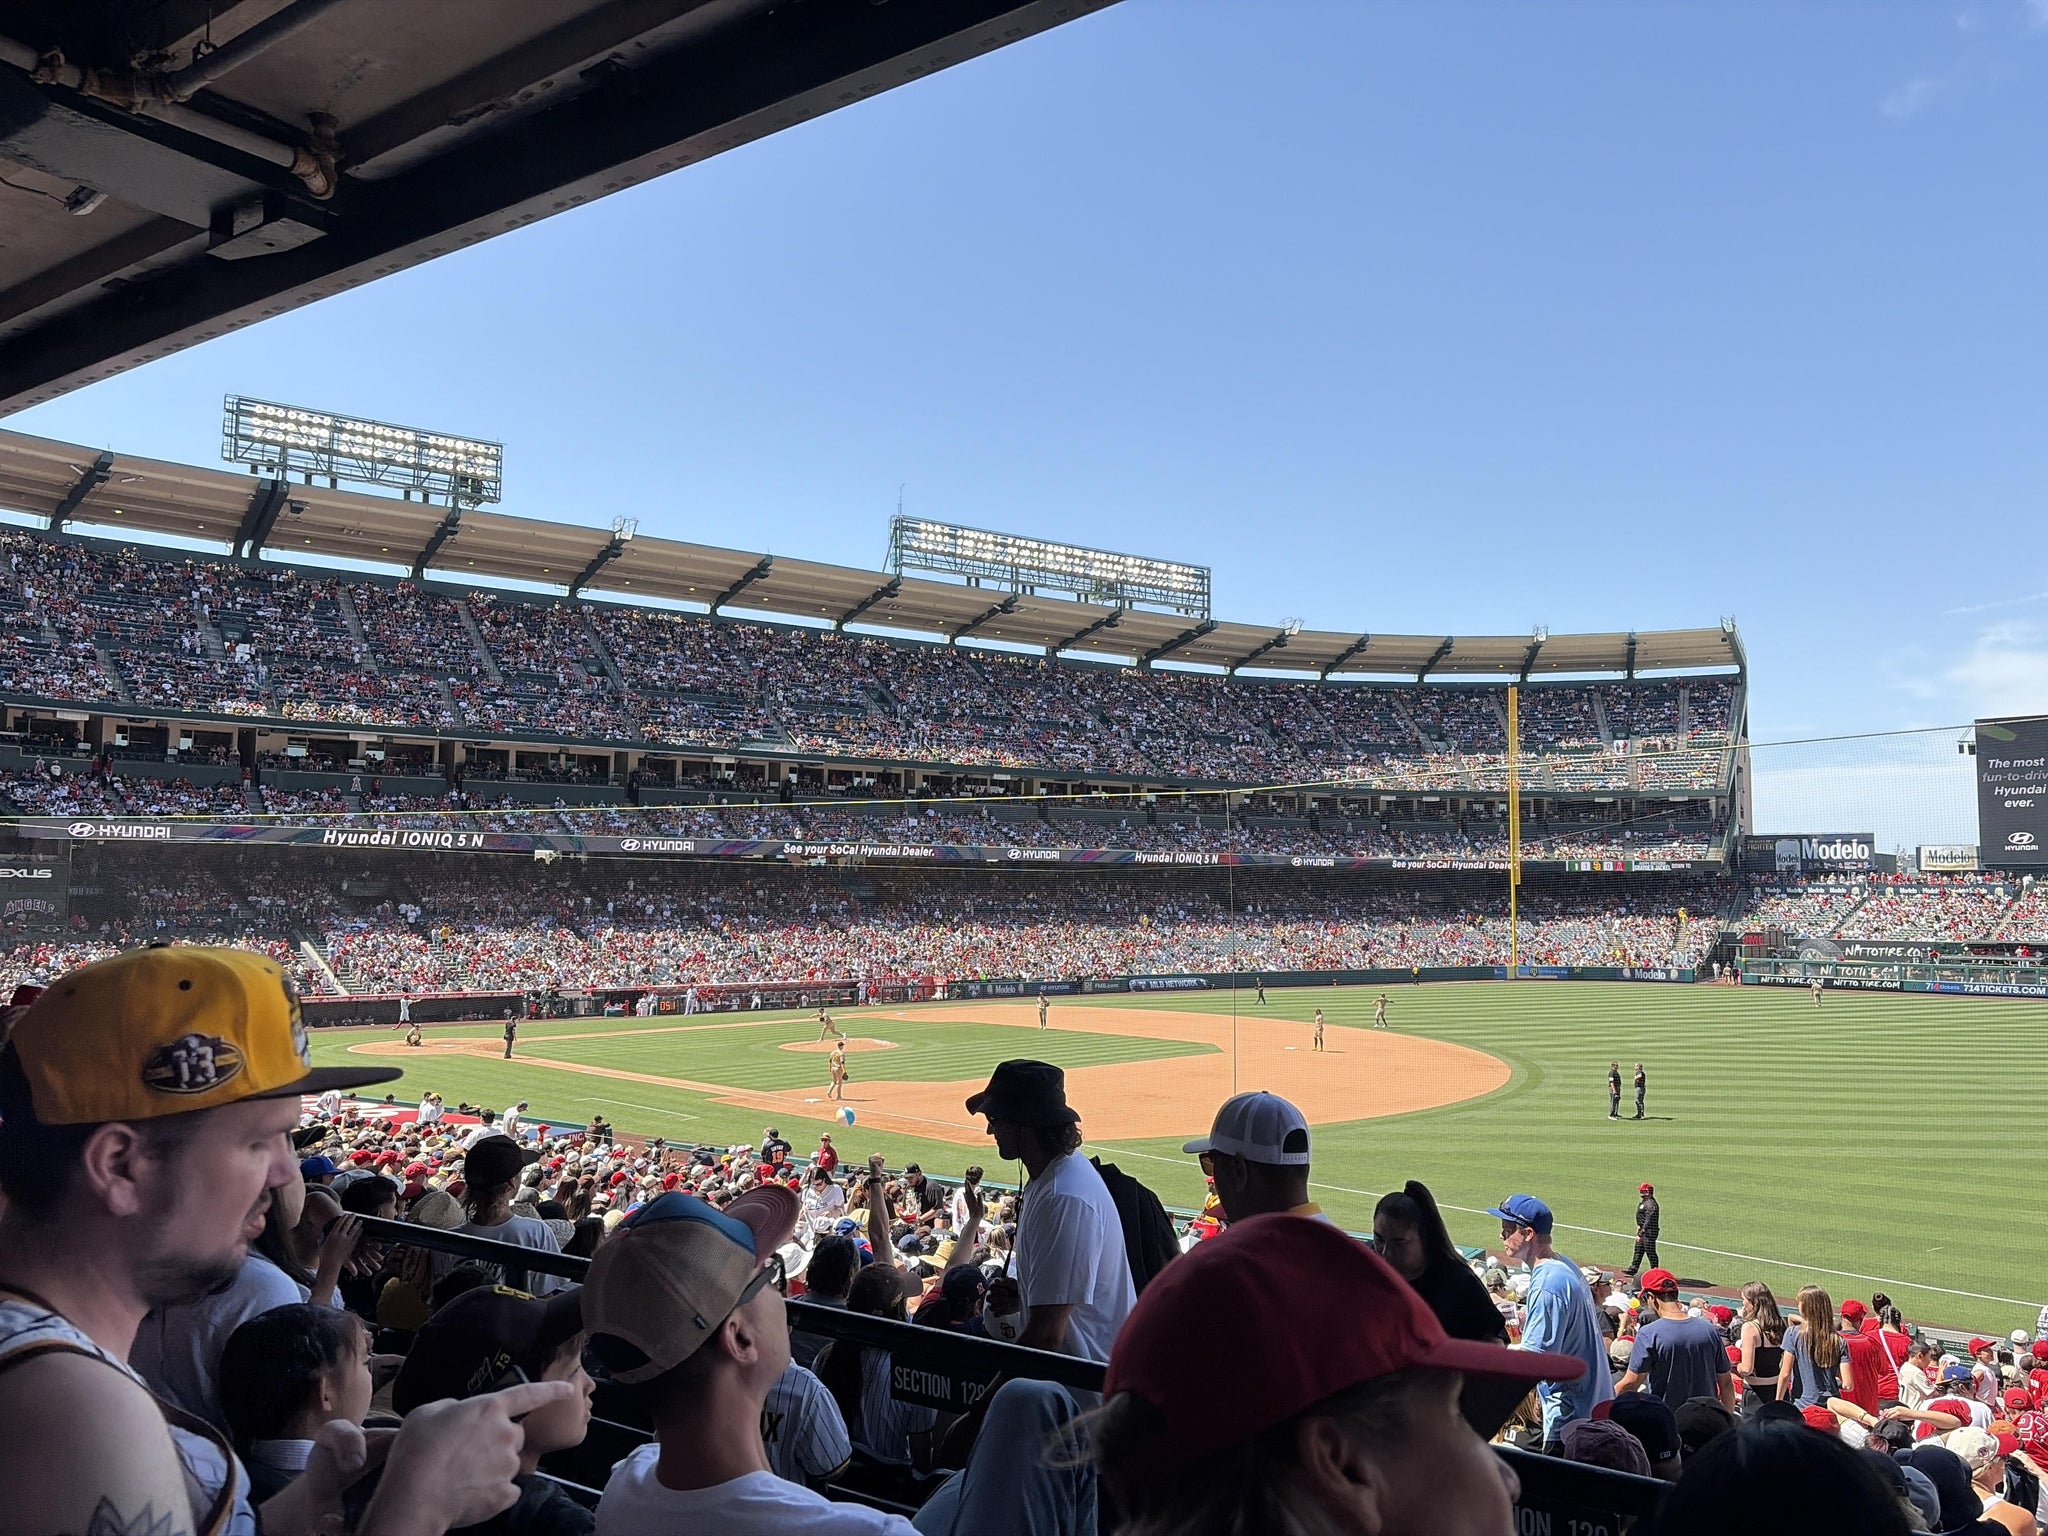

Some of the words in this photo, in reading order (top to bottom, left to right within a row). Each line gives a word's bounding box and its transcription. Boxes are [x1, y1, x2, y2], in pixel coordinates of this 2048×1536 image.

[1988, 759, 2010, 768] The
[2013, 757, 2045, 767] most
[1982, 770, 2048, 782] fun-to-driv
[1994, 784, 2047, 797] Hyundai
[2004, 799, 2035, 808] ever.
[99, 825, 170, 838] HYUNDAI
[323, 830, 397, 845] Hyundai
[402, 832, 452, 847] IONIQ
[457, 835, 466, 846] 5
[471, 835, 484, 847] N
[643, 840, 695, 851] HYUNDAI
[783, 843, 802, 853] See
[804, 845, 828, 855] your
[829, 844, 858, 855] SoCal
[860, 845, 901, 857] Hyundai
[902, 846, 935, 857] Dealer.
[1802, 838, 1869, 859] Modelo
[1023, 850, 1060, 859] HYUNDAI
[1135, 852, 1173, 863] Hyundai
[1175, 853, 1202, 864] IONIQ
[1204, 855, 1209, 863] 5
[1211, 854, 1219, 864] N
[1929, 850, 1970, 863] Modelo
[1303, 859, 1334, 867] HYUNDAI
[1392, 860, 1406, 868] See
[1407, 861, 1425, 870] your
[1426, 861, 1450, 869] SoCal
[1452, 861, 1486, 870] Hyundai
[1488, 861, 1518, 870] Deale.
[0, 868, 52, 878] EXUS
[3, 898, 55, 917] ANGELS
[1635, 969, 1665, 979] Modelo
[996, 984, 1015, 993] Modelo
[1166, 979, 1198, 988] NETWORK
[1861, 981, 1900, 989] TIRE.COM
[1964, 984, 2046, 995] 714TICKETS.COM
[772, 1151, 783, 1163] 19
[894, 1365, 950, 1401] SECTION
